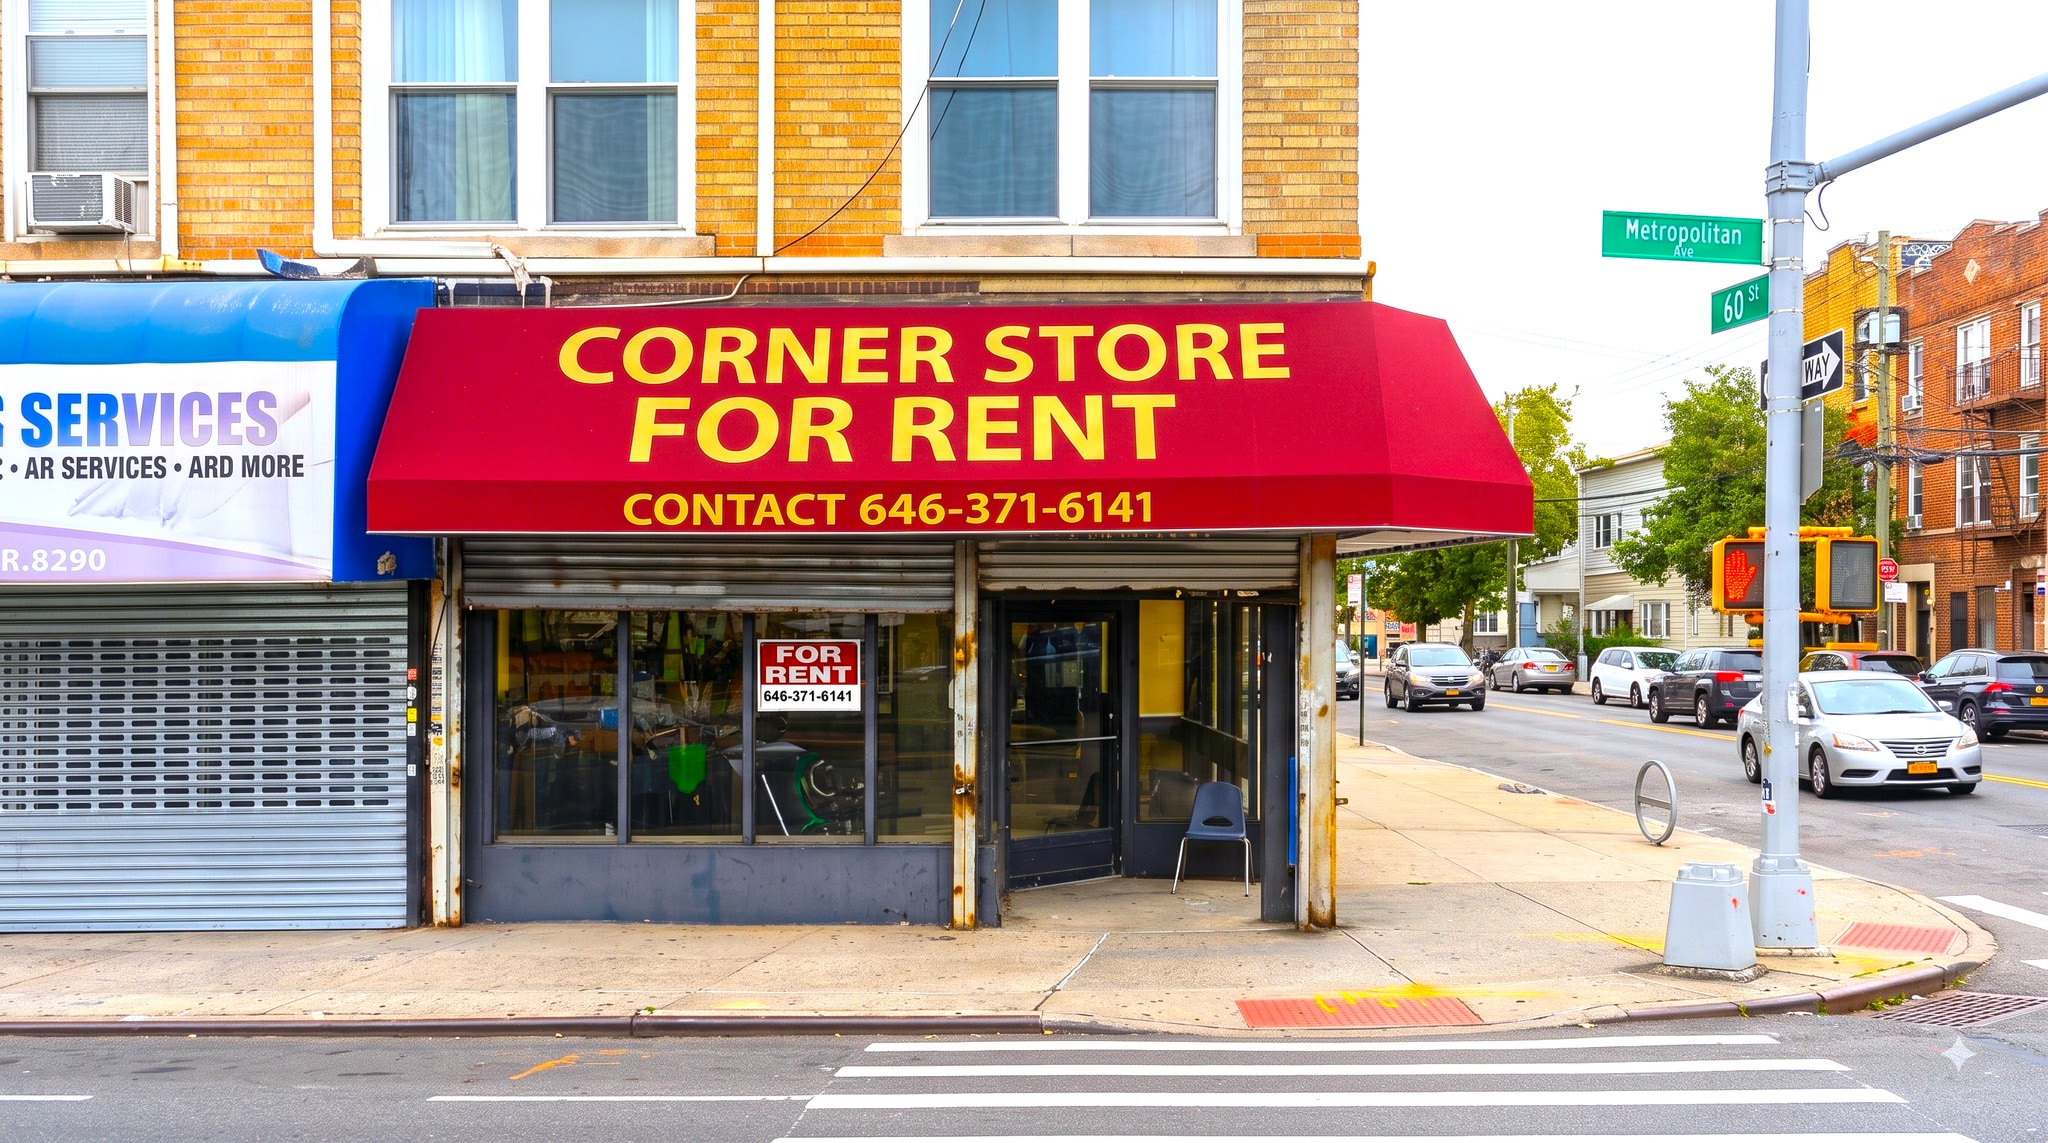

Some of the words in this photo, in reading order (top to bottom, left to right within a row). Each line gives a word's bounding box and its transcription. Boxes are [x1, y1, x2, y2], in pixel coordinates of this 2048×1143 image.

[1625, 218, 1742, 247] Metropolitan
[1673, 245, 1694, 258] Ave
[1723, 289, 1744, 323] 60
[1748, 283, 1759, 302] St
[558, 326, 954, 385] CORNER
[983, 322, 1291, 383] STORE
[1804, 352, 1830, 384] WAY
[20, 391, 278, 448] SERVICES
[628, 396, 854, 464] FOR
[891, 394, 1176, 462] RENT
[24, 456, 55, 480] AR
[62, 456, 167, 480] SERVICES
[188, 456, 235, 479] ARD
[241, 455, 305, 478] MORE
[623, 493, 846, 526] CONTACT
[859, 491, 1152, 526] 646-371-6141
[1, 548, 107, 572] R.8290
[776, 645, 842, 664] FOR
[765, 665, 852, 684] RENT
[763, 690, 852, 702] 646-371-6141
